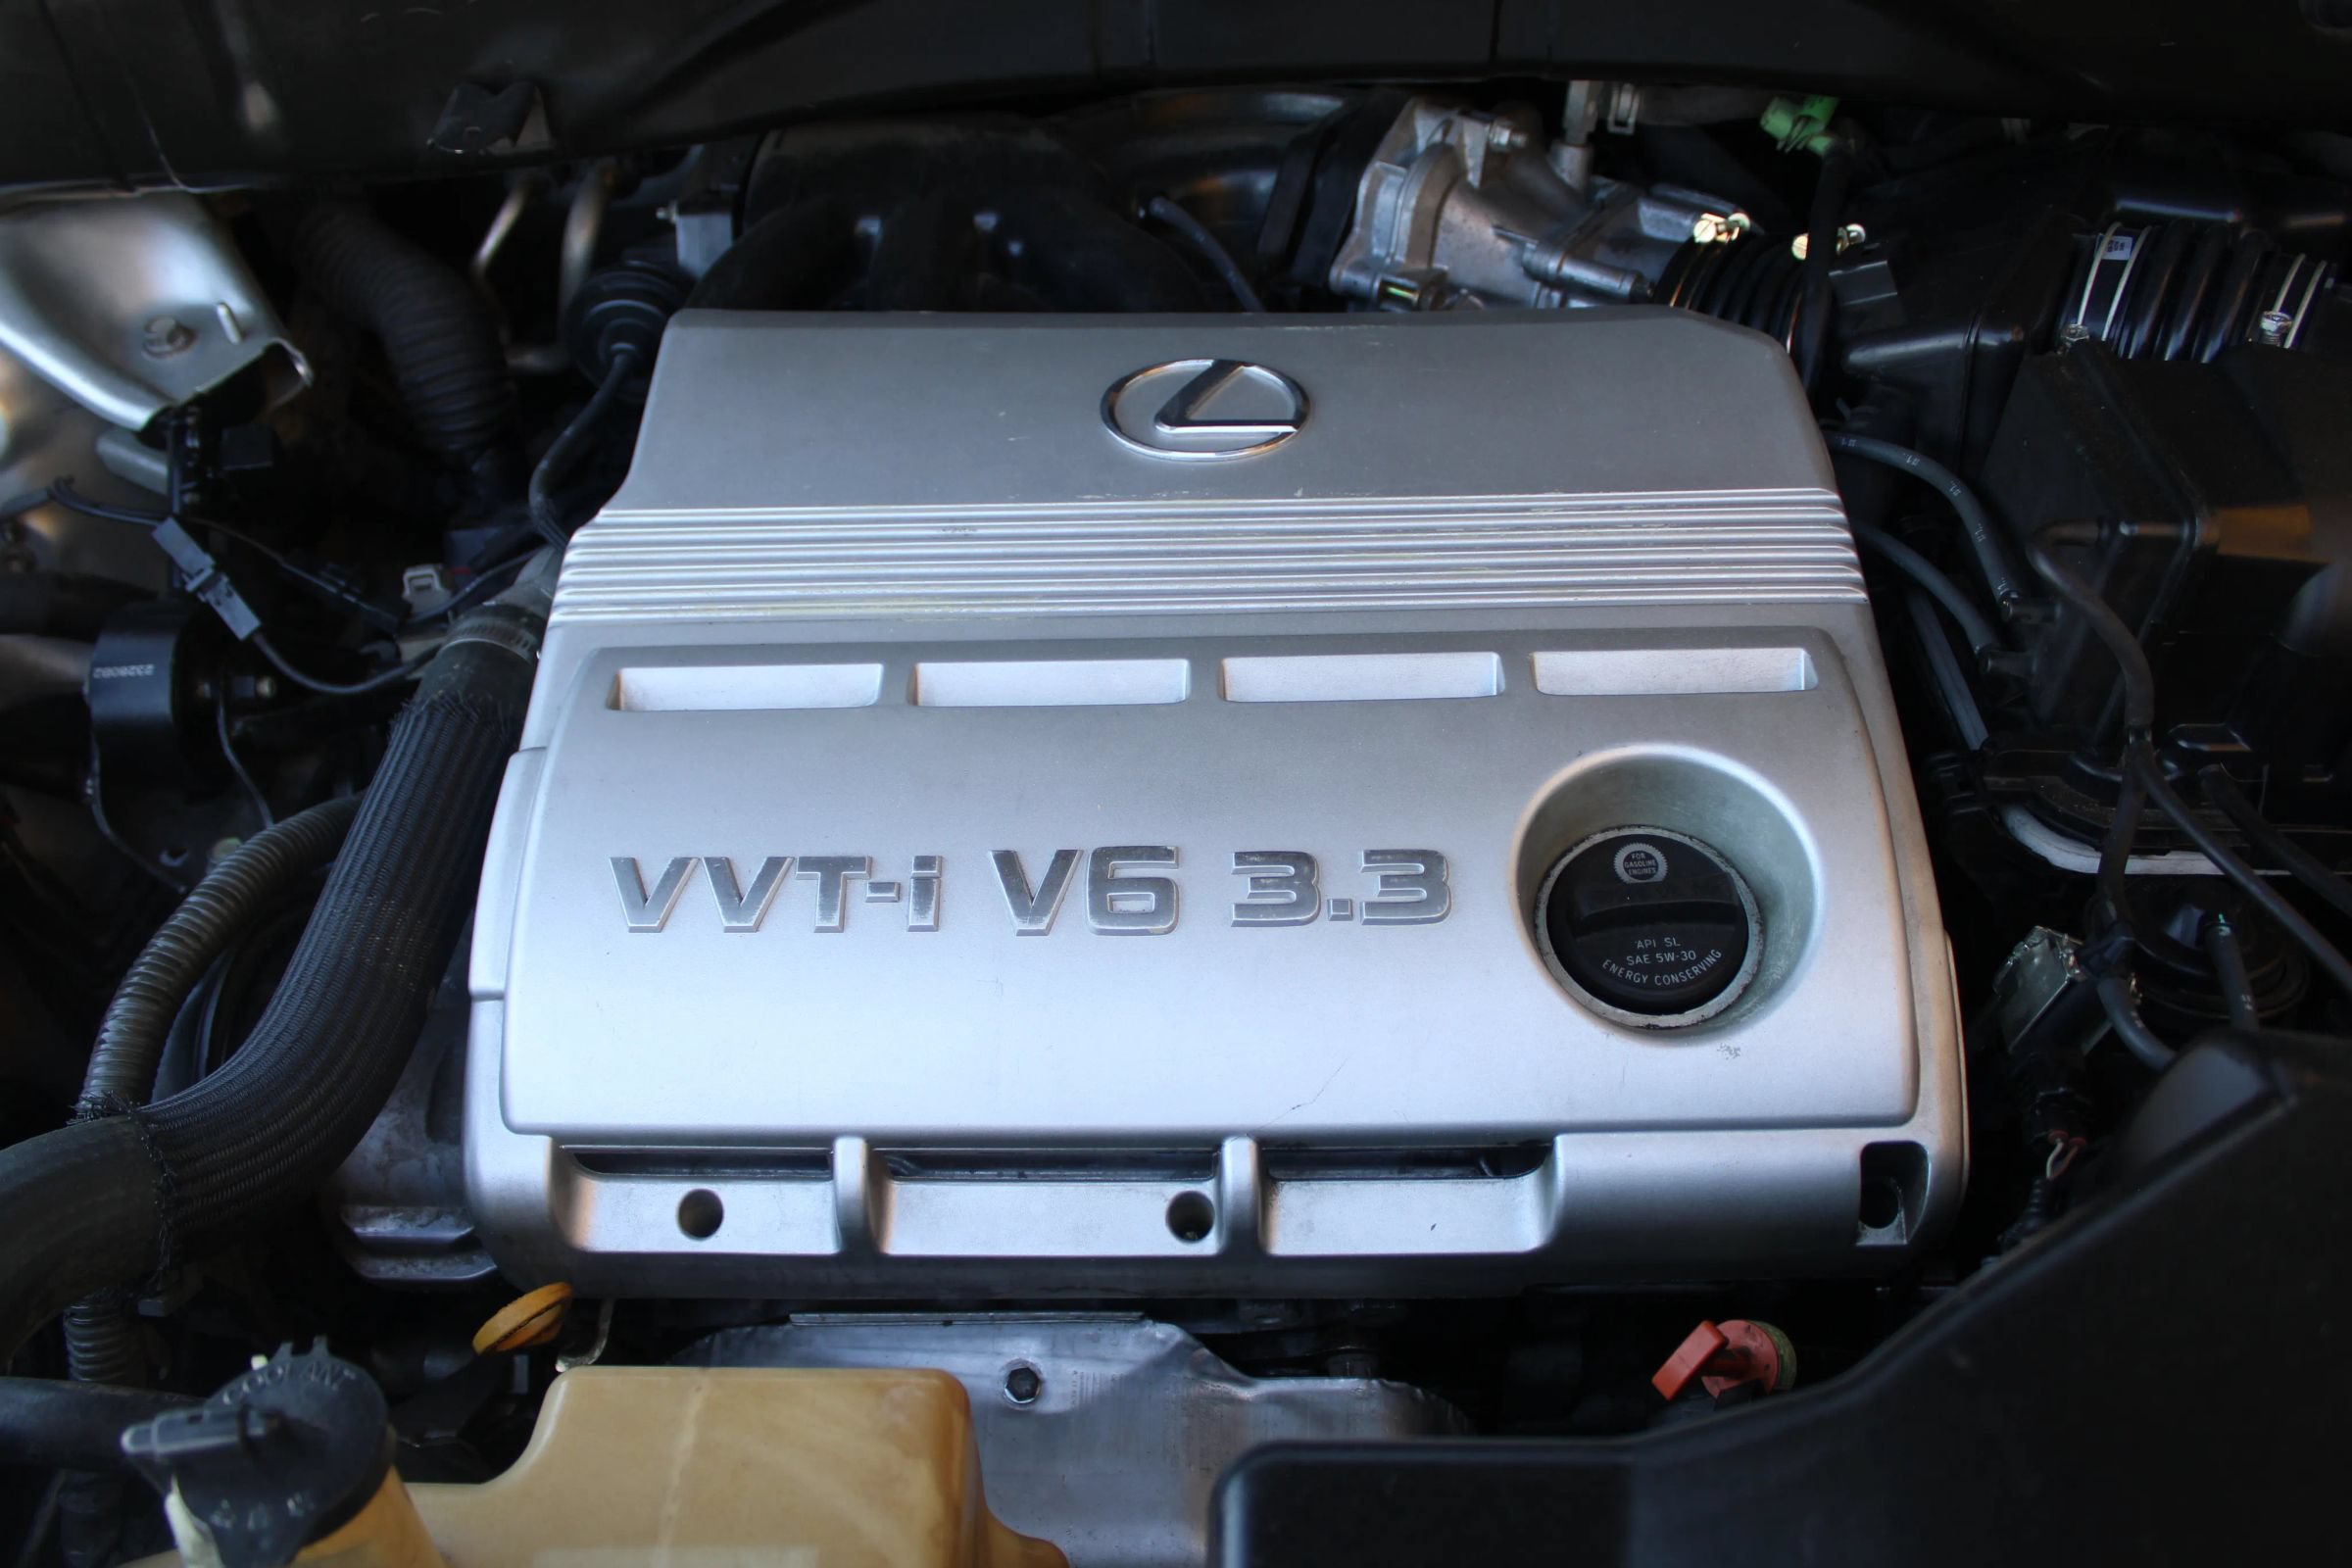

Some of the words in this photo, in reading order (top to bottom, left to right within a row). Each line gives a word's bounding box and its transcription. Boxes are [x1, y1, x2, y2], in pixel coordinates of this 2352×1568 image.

[1631, 852, 1646, 860] FOR
[1623, 859, 1657, 869] GASOLINE
[1628, 866, 1657, 876] ENGINES
[609, 855, 943, 933] VVT-i
[989, 846, 1179, 937] V6
[1230, 849, 1453, 927] 3.3
[1637, 939, 1657, 950] API
[1663, 937, 1681, 948] SL
[1626, 954, 1652, 966] SAE
[1655, 950, 1697, 963] 5W-30
[1601, 958, 1648, 985] ENERGY
[1653, 948, 1723, 986] CONSERVING
